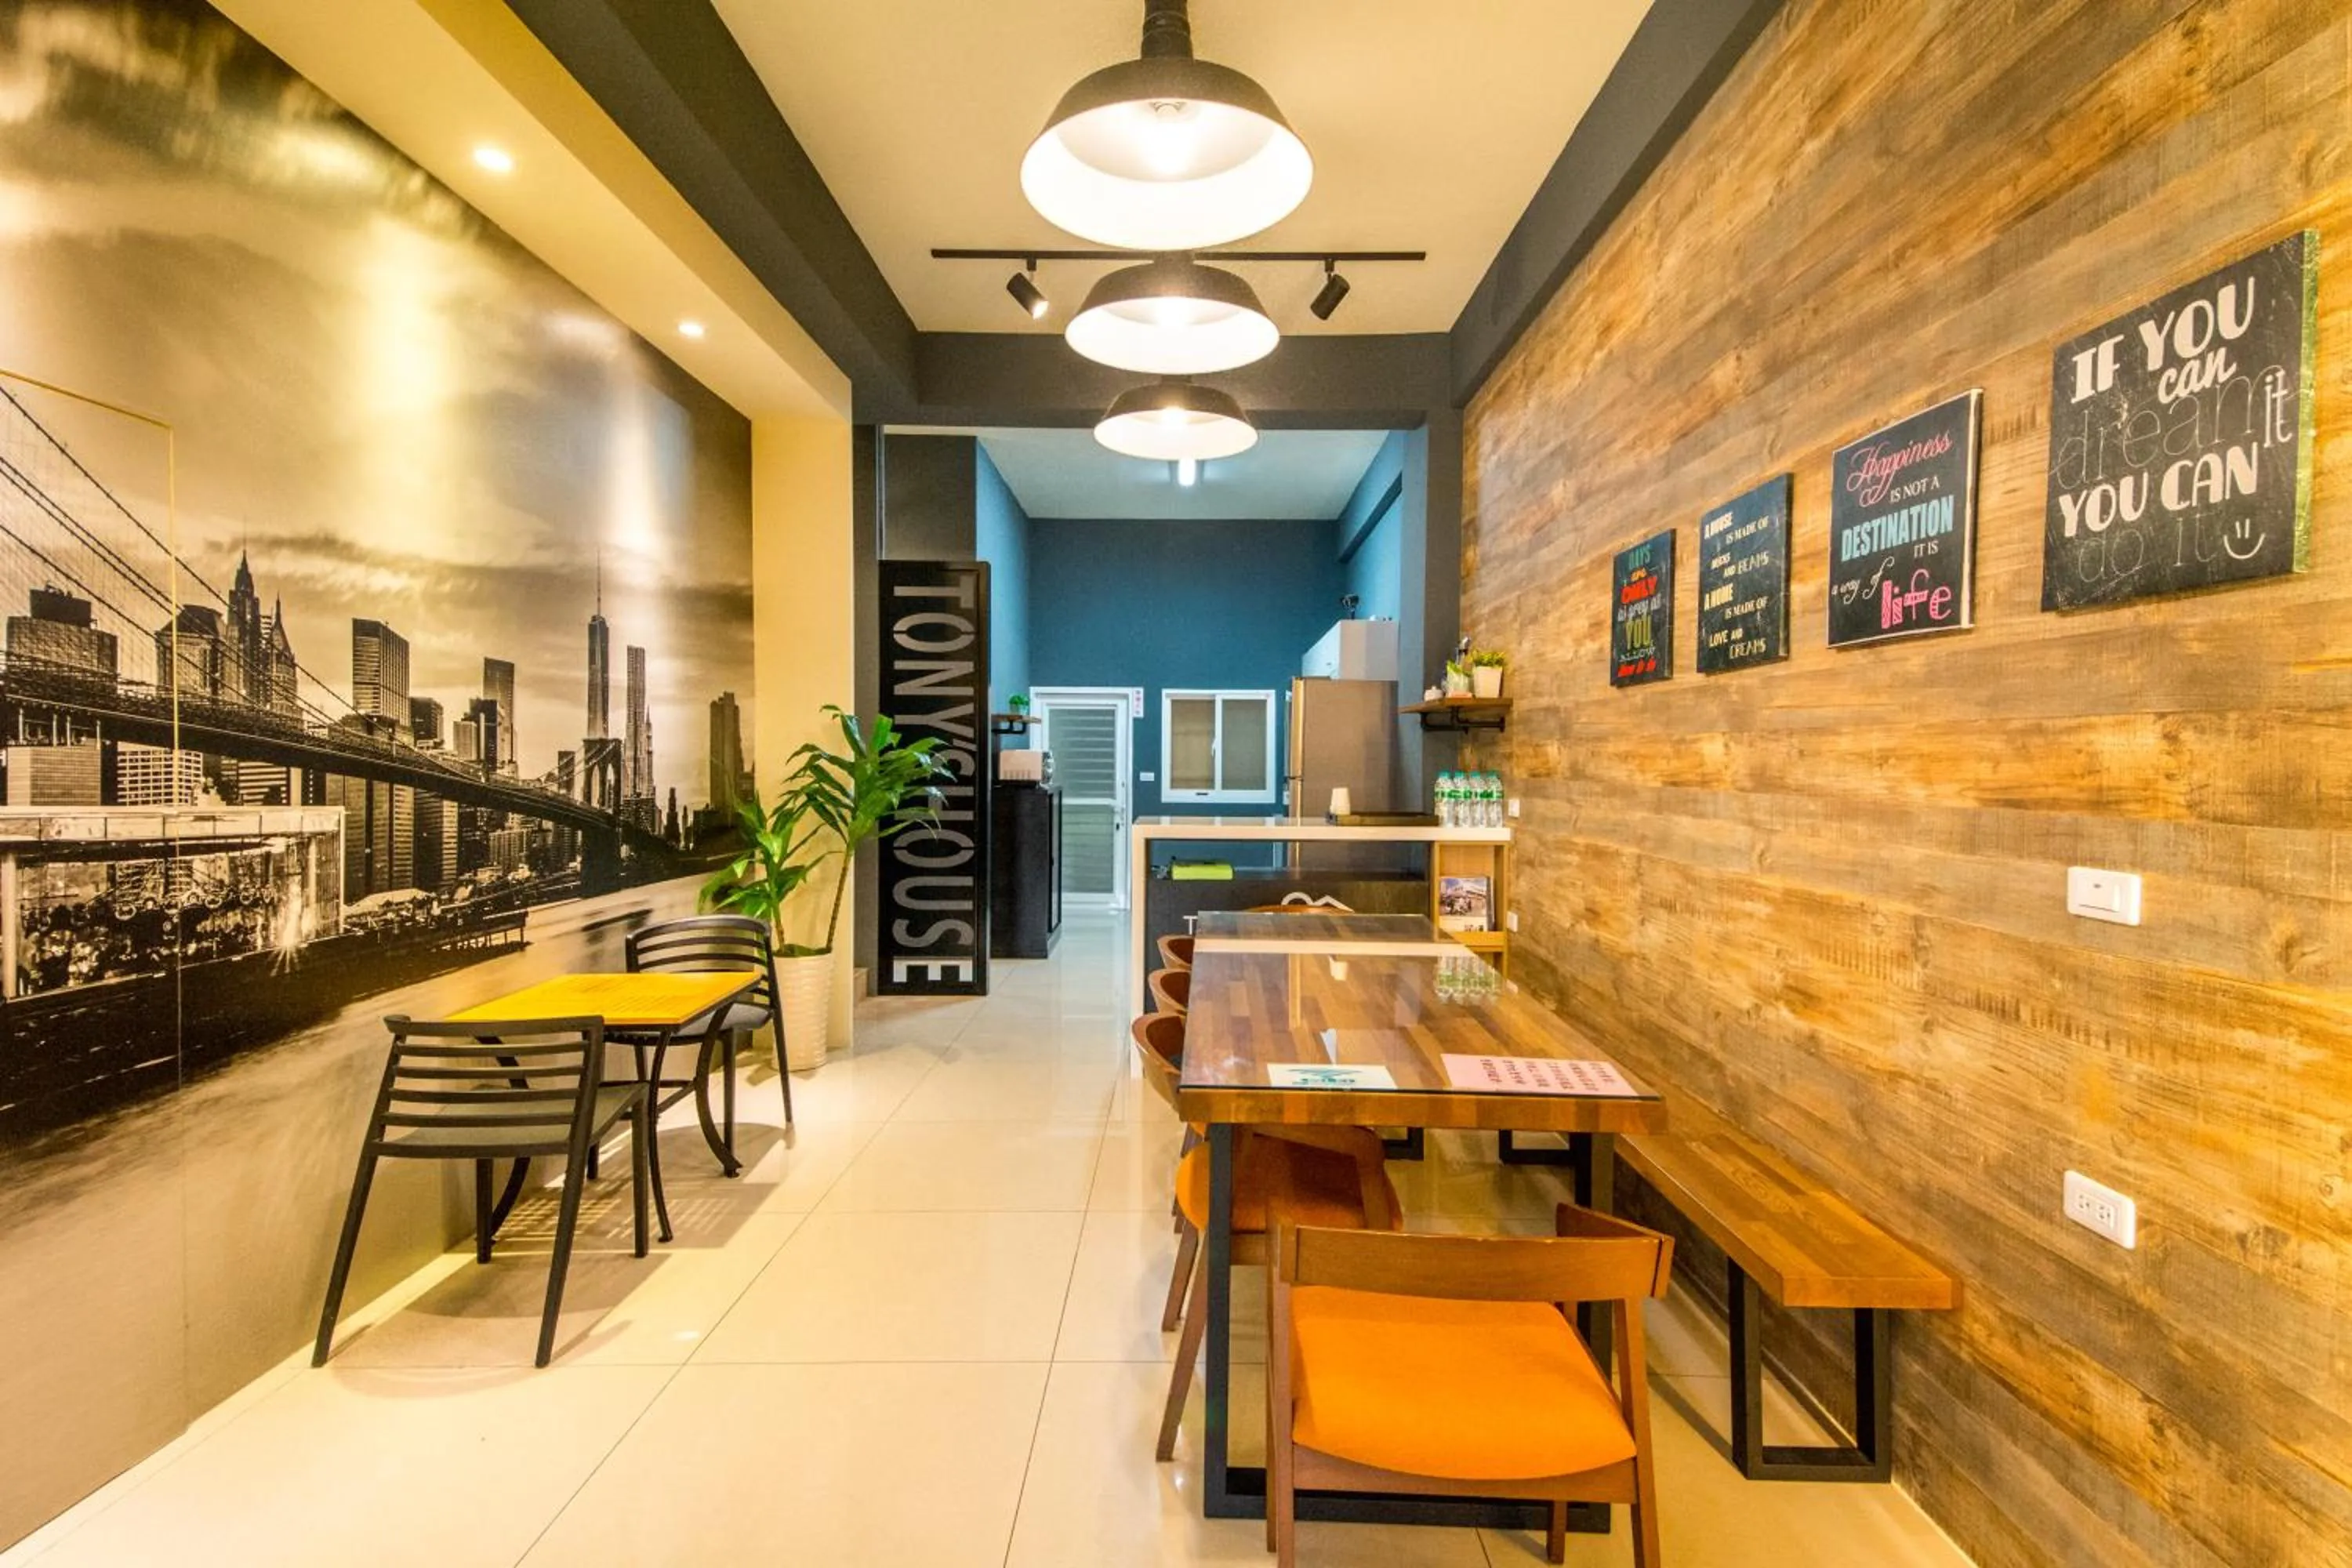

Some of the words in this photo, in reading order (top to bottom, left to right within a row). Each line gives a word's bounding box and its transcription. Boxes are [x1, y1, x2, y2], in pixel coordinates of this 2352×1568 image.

[2071, 334, 2124, 404] IF
[2139, 276, 2255, 372] YOU
[2158, 347, 2238, 405] can
[2052, 365, 2283, 490] dream
[2263, 368, 2294, 448] it
[1846, 430, 1953, 507] Happiness
[1890, 488, 1901, 503] IS
[1903, 477, 1929, 500] NOT
[1930, 475, 1940, 490] A
[2058, 471, 2149, 537] YOU
[2160, 441, 2259, 512] CAN
[1842, 495, 1955, 562] DESTINATION
[1914, 543, 1927, 558] IT
[1928, 539, 1939, 554] IS
[1882, 568, 1951, 629] life
[1709, 630, 1728, 648] LOVE
[893, 785, 977, 983] HOUSE
